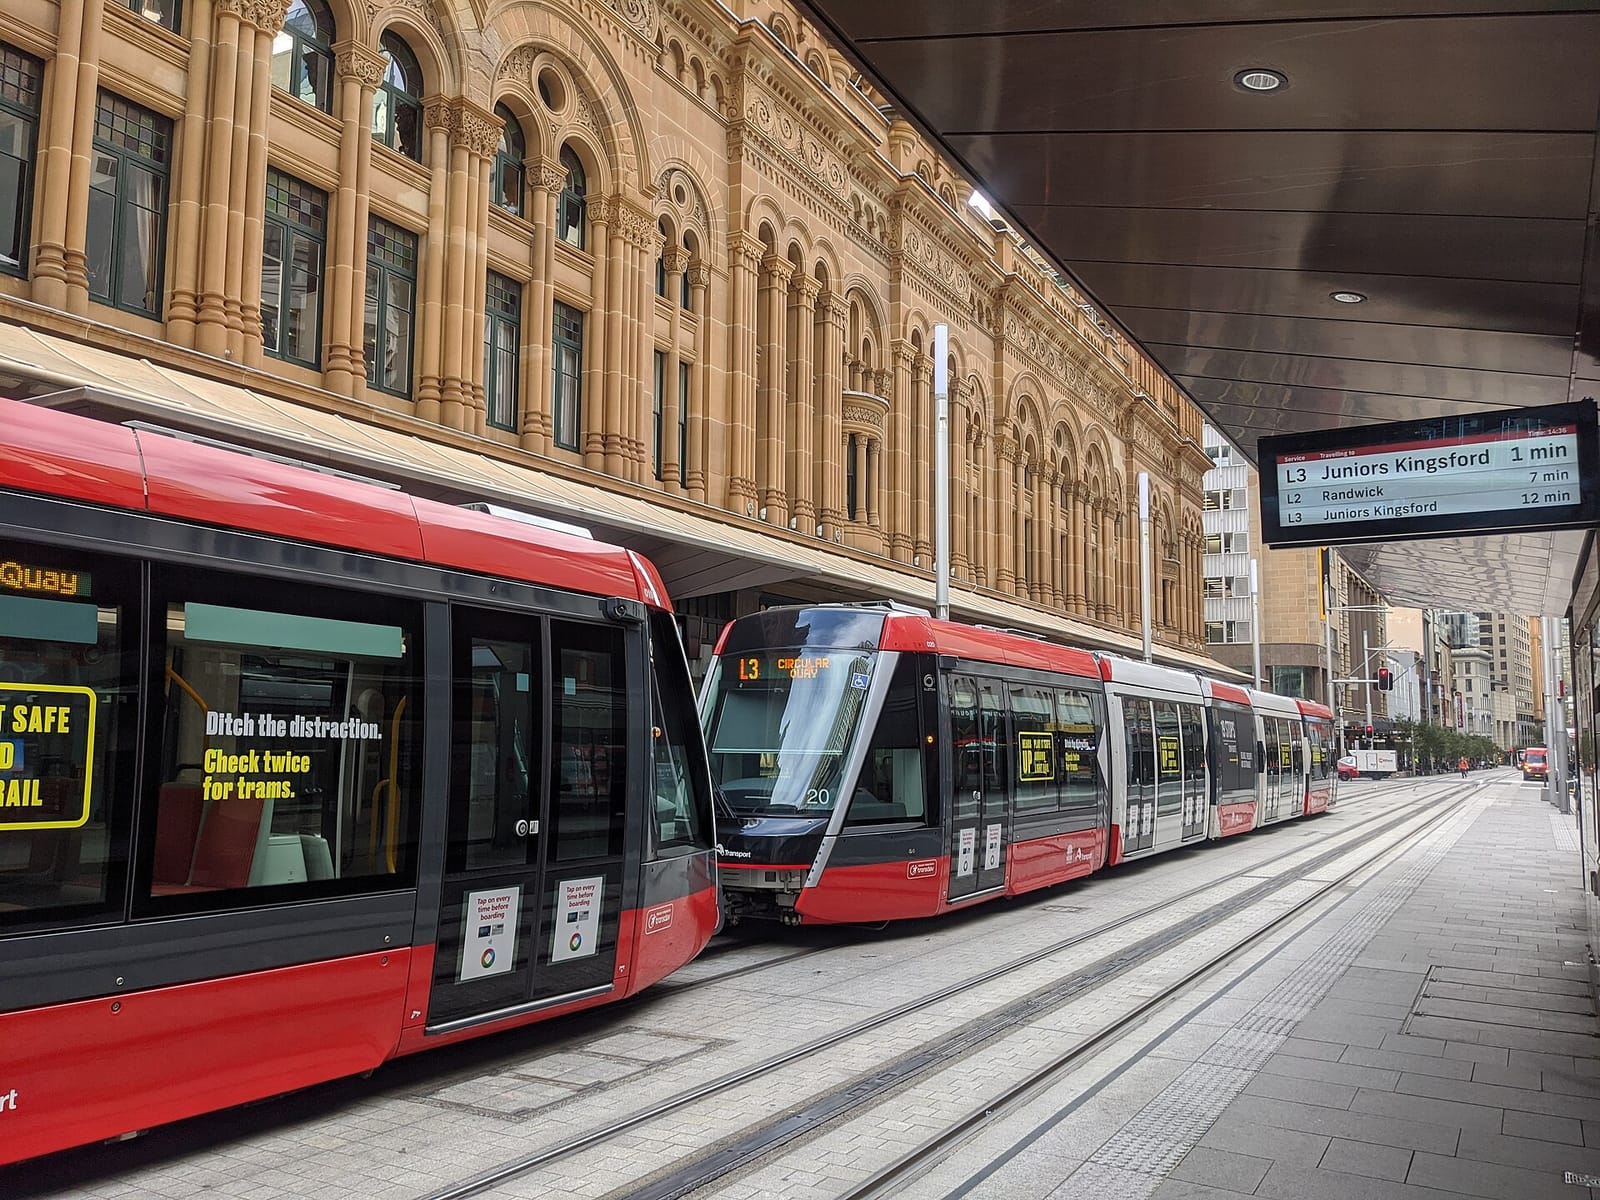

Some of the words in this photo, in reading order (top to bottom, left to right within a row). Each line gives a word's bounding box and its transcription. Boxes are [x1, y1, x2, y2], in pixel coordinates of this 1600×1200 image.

[1284, 455, 1306, 463] Service
[1286, 468, 1307, 484] L3
[1321, 462, 1389, 480] Juniors
[1395, 448, 1490, 474] Kingsford
[1511, 446, 1523, 462] 1
[1530, 443, 1567, 460] min
[1287, 493, 1302, 504] L2
[1322, 486, 1384, 501] Randwick
[1529, 471, 1538, 483] 7
[1543, 469, 1569, 482] min
[1288, 513, 1302, 523] L3
[1323, 508, 1370, 521] Juniors
[1374, 500, 1437, 517] Kingsford
[1521, 492, 1540, 505] 12
[1544, 490, 1570, 503] min
[0, 561, 78, 595] Quay
[740, 658, 759, 680] L3
[777, 657, 830, 669] CIRCULAR
[12, 704, 71, 733] SAFE
[206, 711, 254, 737] Ditch
[258, 713, 287, 738] the
[290, 714, 383, 740] distraction.
[204, 748, 260, 774] Check
[263, 750, 311, 773] twice
[203, 776, 234, 801] for
[237, 776, 296, 800] trams.
[807, 788, 830, 805] 20
[725, 849, 751, 859] Transport
[583, 884, 596, 892] every
[477, 898, 487, 906] Tap
[496, 895, 511, 904] every
[478, 905, 491, 913] time
[491, 903, 509, 911] before
[480, 911, 505, 921] boarding
